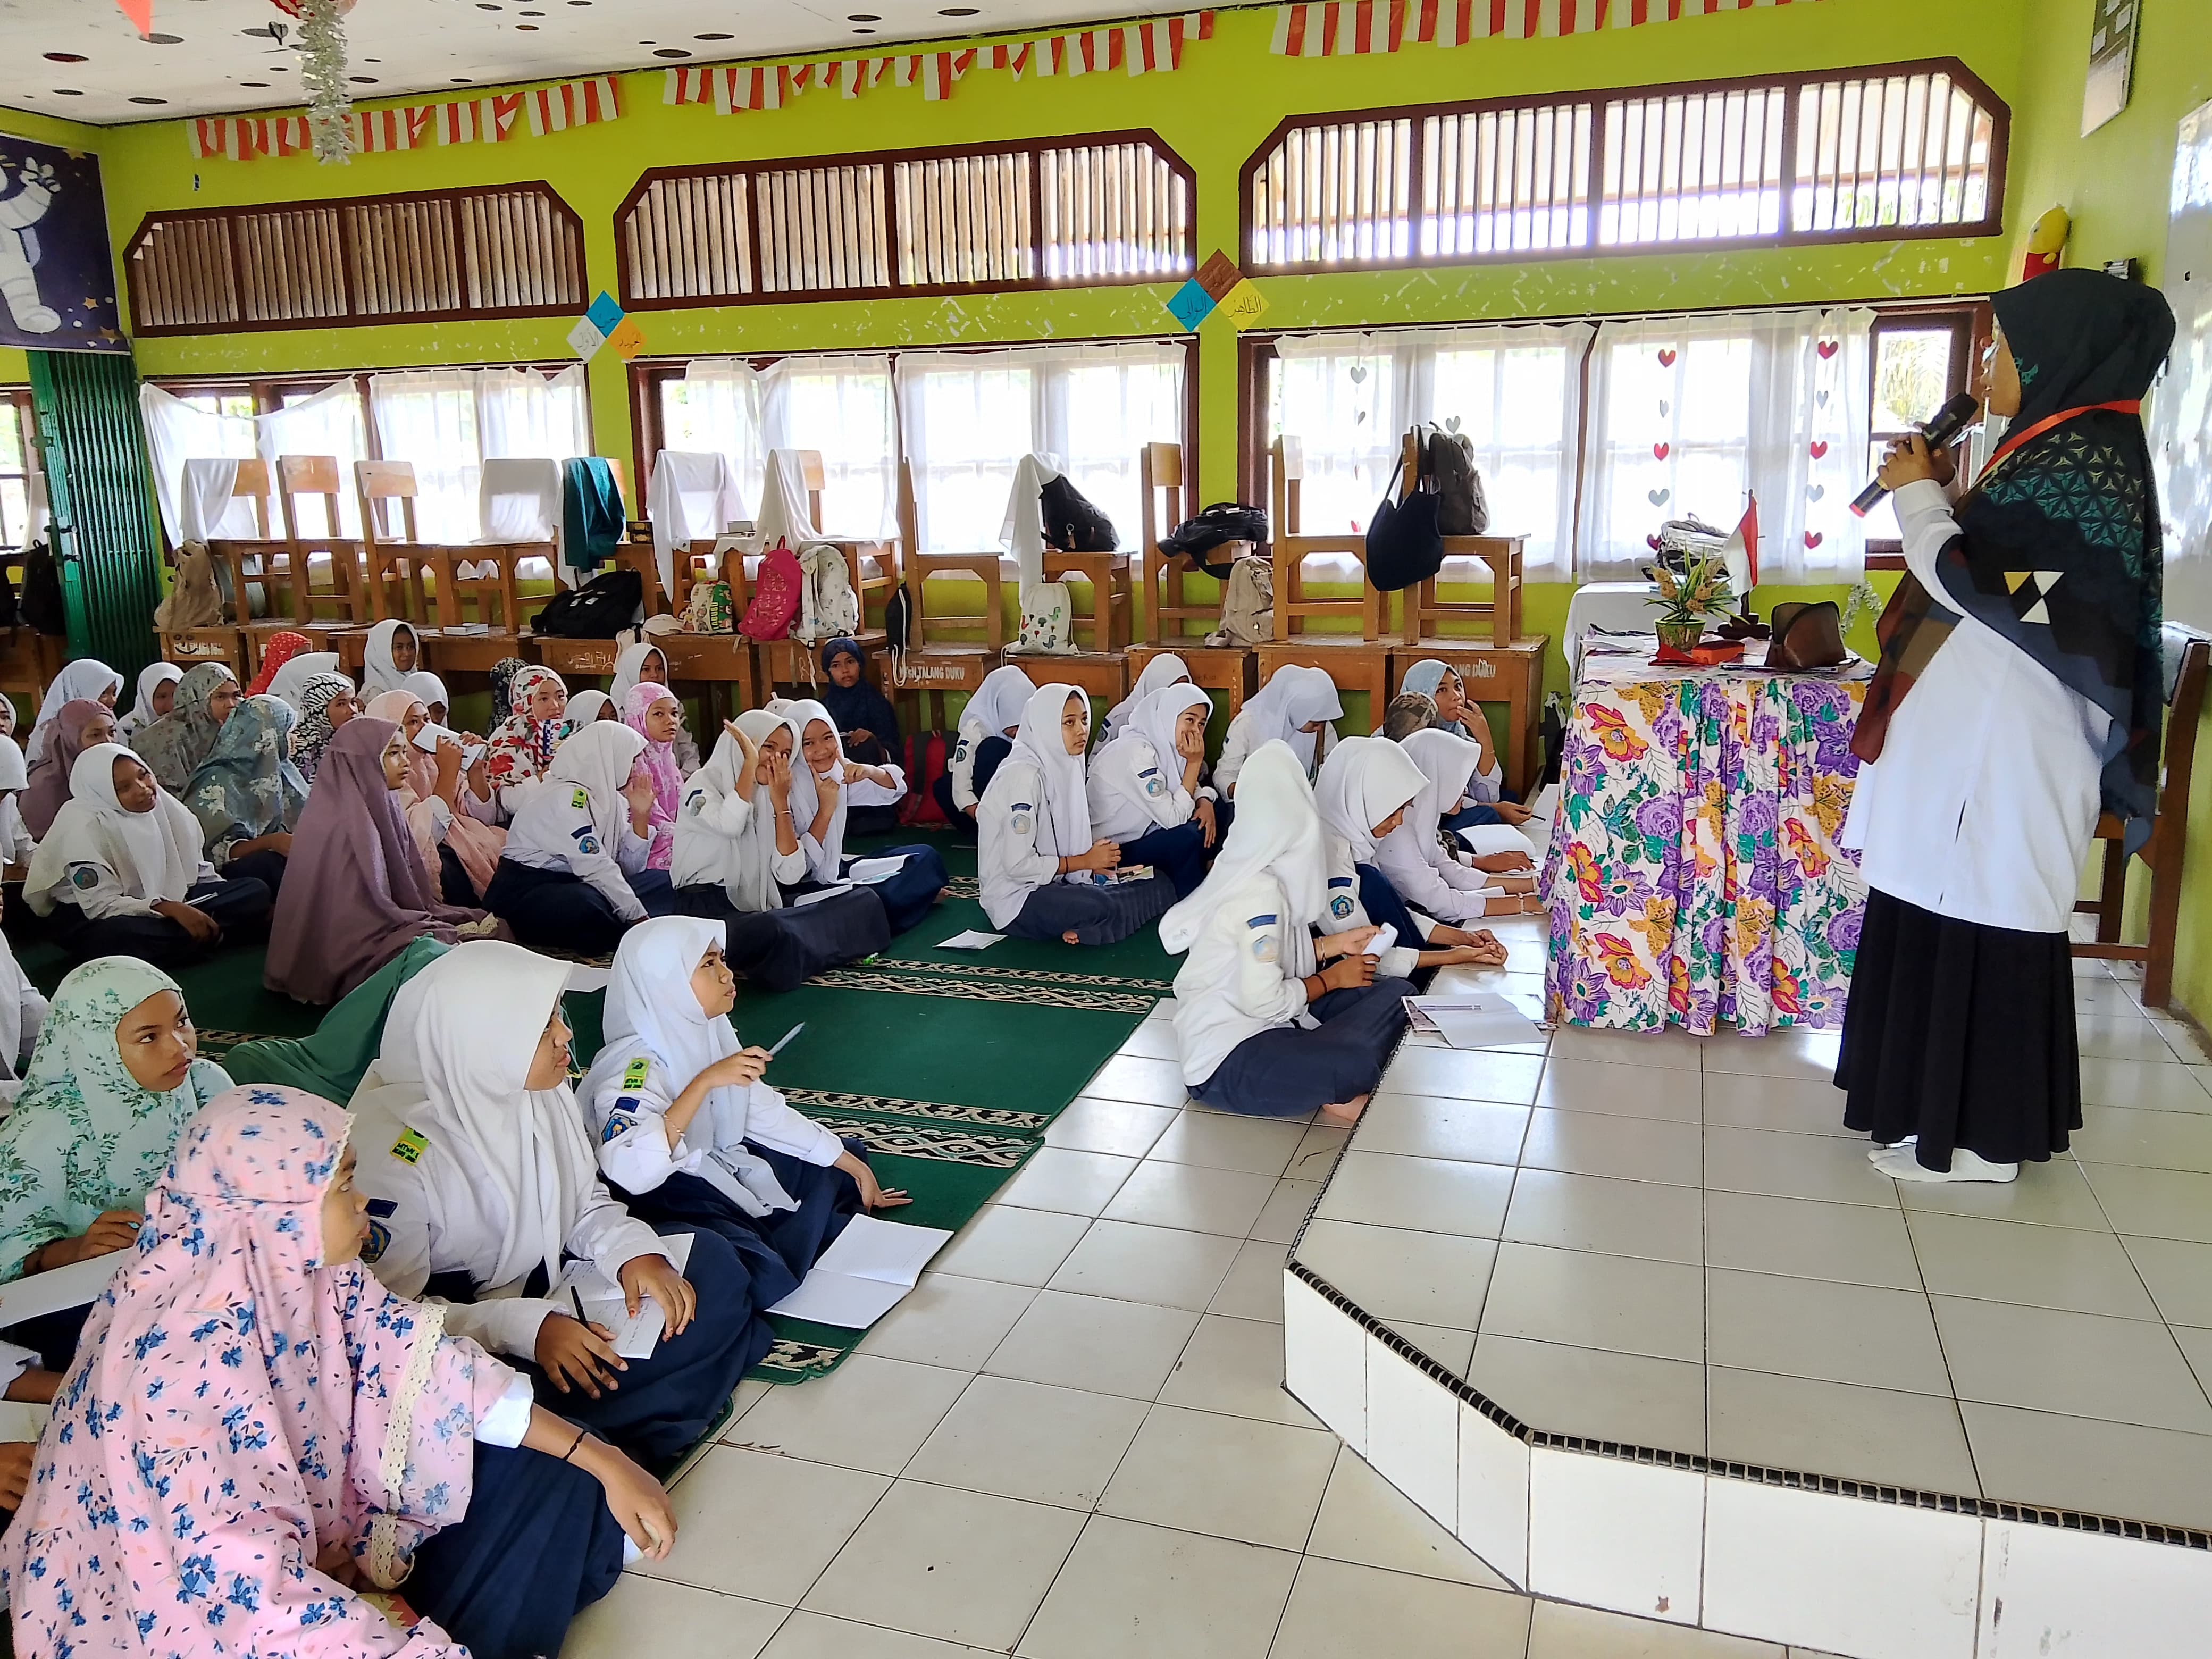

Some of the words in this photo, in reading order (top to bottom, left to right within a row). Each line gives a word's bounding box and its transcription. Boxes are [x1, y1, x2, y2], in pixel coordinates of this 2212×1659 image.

[710, 602, 719, 630] LABUBU
[917, 666, 944, 680] TALANG
[945, 666, 965, 680] DUKU
